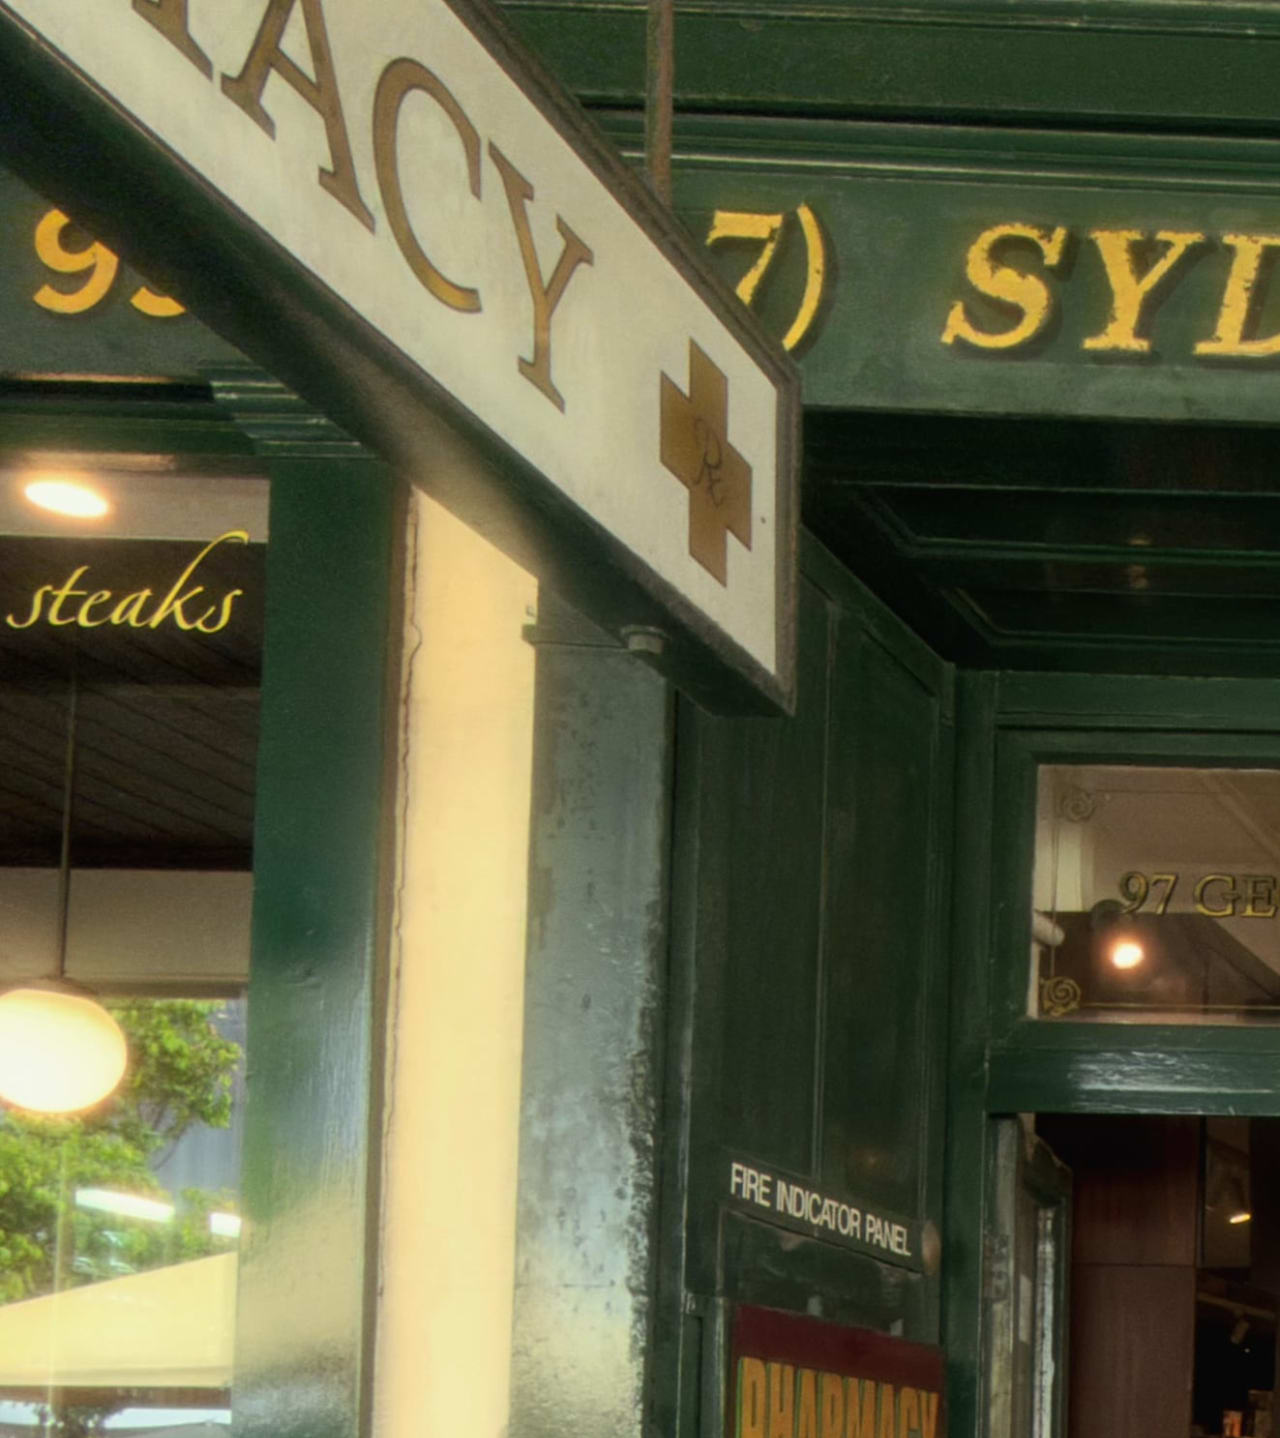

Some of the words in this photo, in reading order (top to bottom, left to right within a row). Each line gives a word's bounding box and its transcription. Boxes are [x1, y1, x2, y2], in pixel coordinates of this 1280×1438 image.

[33, 208, 186, 318] 9
[6, 529, 249, 633] steaks
[1118, 872, 1179, 917] 97
[730, 1161, 773, 1208] FIRE
[776, 1179, 861, 1240] INDICATOR
[865, 1213, 912, 1257] PANEL
